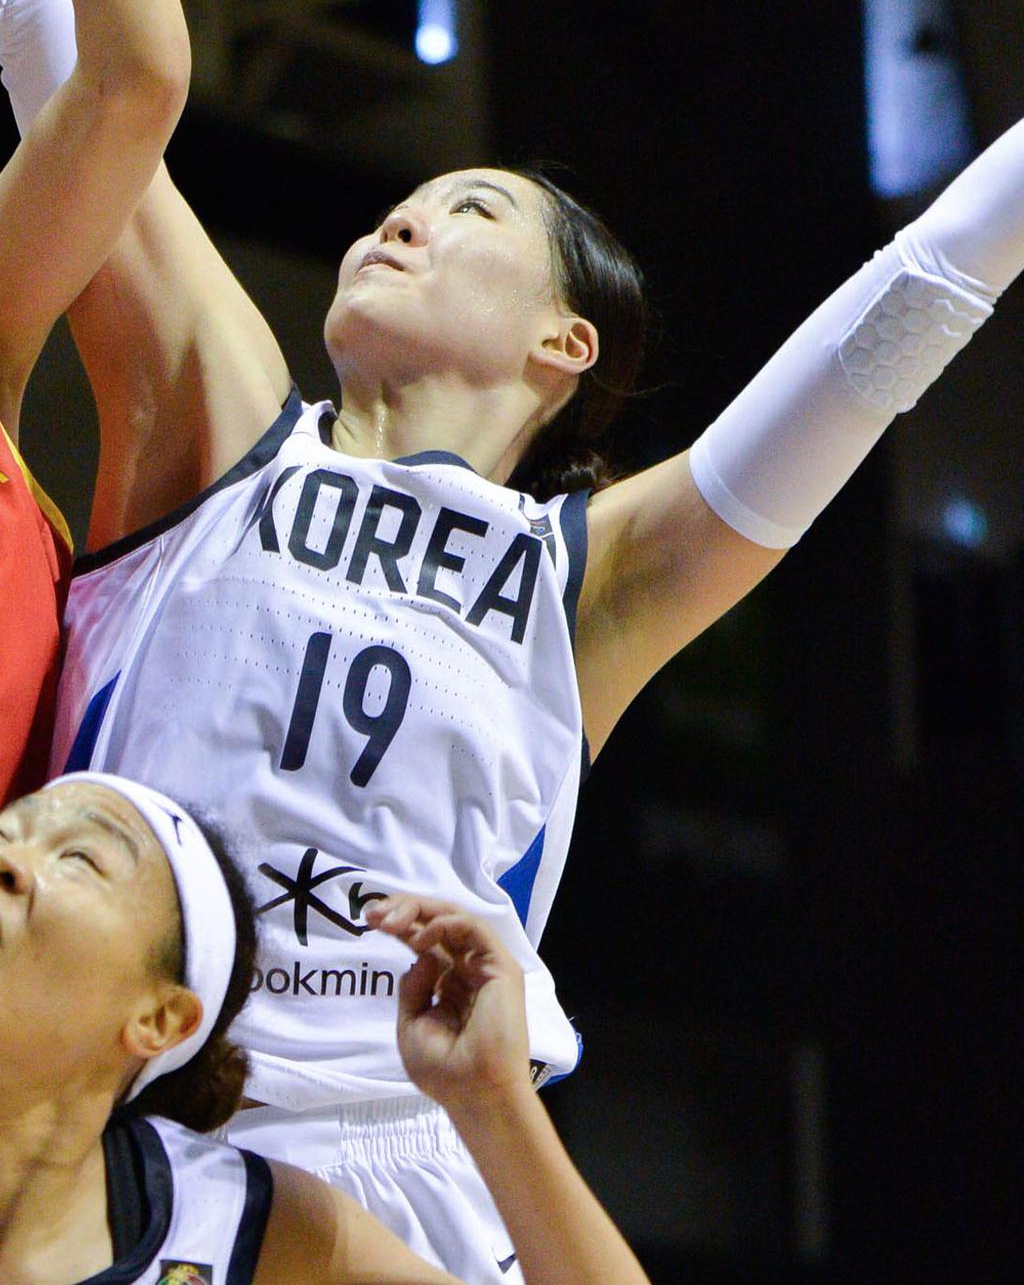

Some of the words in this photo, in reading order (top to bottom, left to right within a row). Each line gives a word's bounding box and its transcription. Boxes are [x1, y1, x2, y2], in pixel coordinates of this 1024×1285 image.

[257, 465, 543, 645] KOREA
[279, 631, 412, 789] 19
[249, 961, 395, 997] ookmin
